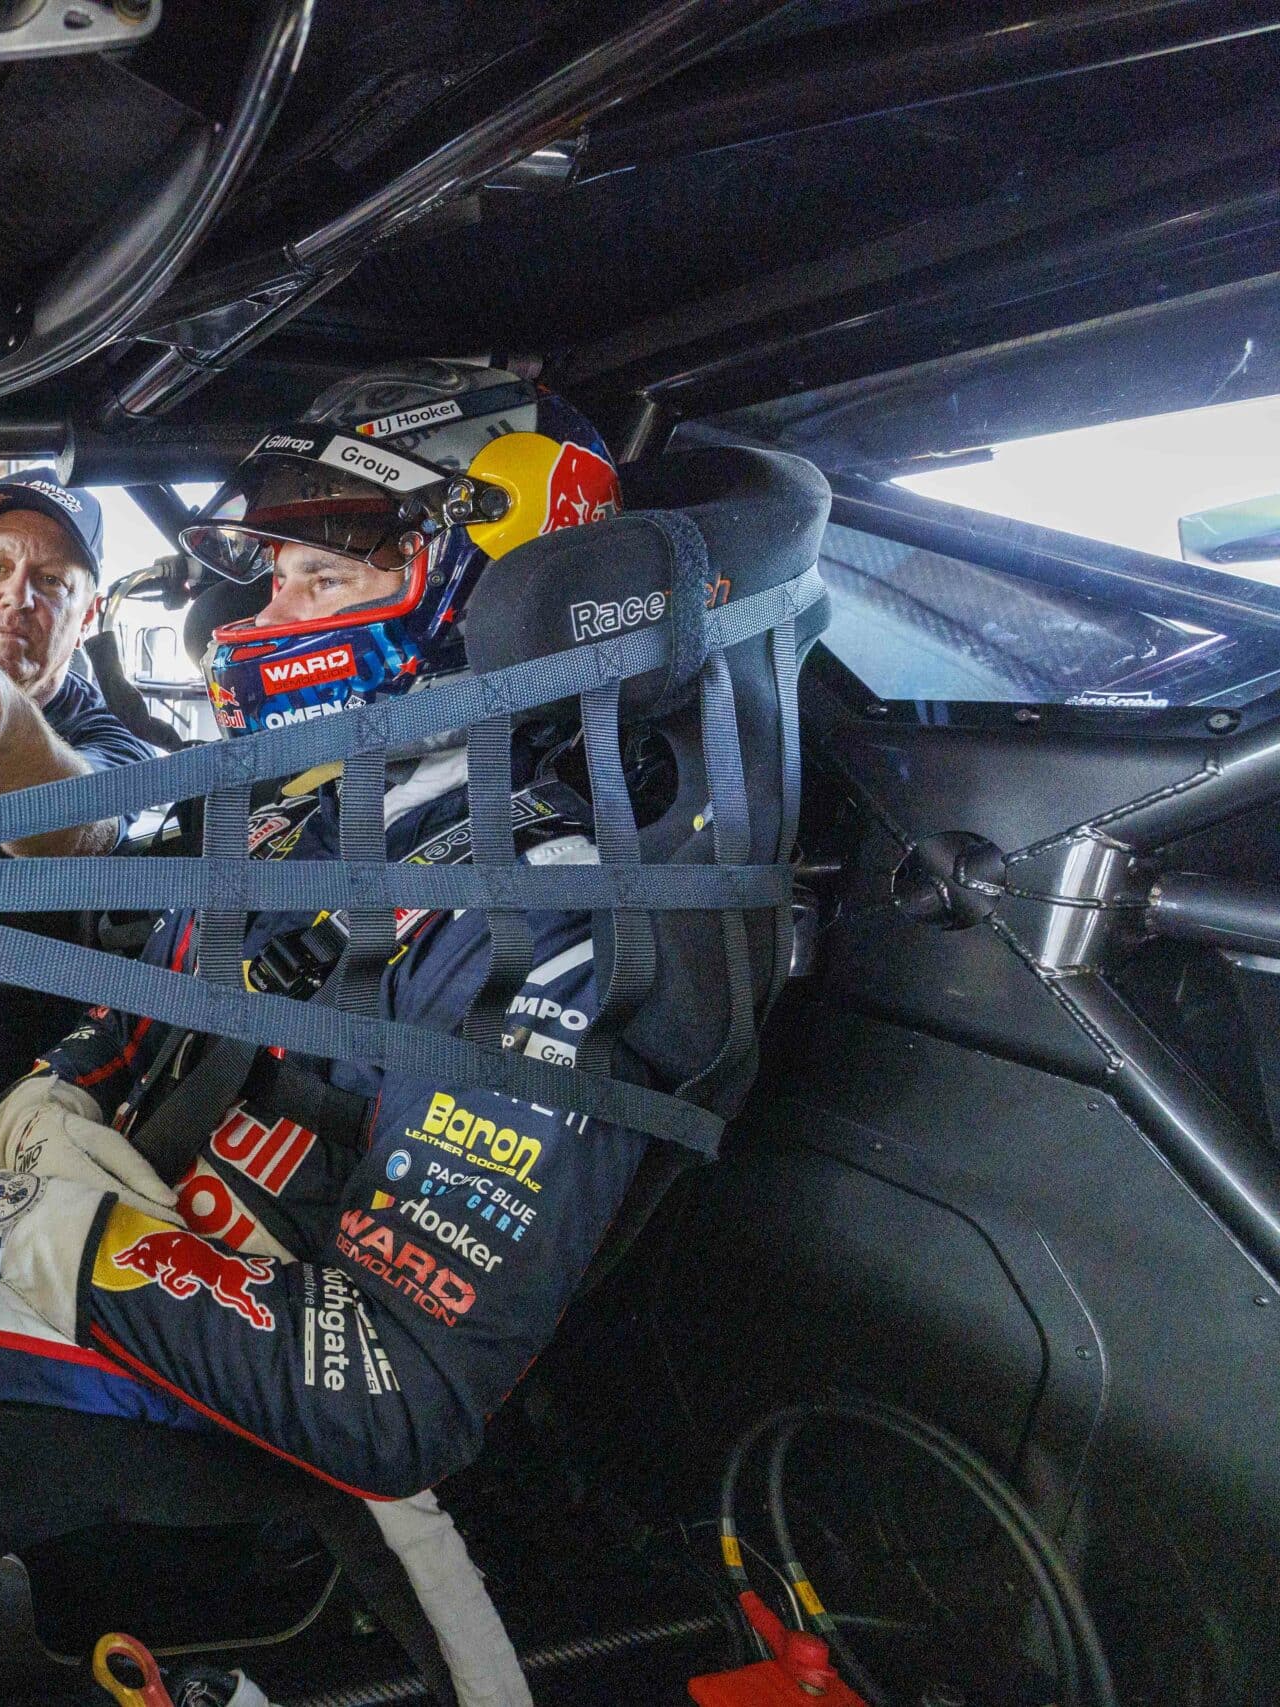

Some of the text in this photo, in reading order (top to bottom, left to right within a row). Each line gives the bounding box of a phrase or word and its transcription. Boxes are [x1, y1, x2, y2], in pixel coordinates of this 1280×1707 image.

[378, 420, 394, 434] LJ
[398, 404, 456, 428] Hooker
[267, 434, 401, 483] Giltrap Group
[31, 480, 84, 512] AMPOL
[570, 591, 666, 642] Race
[264, 650, 350, 682] WARD
[266, 700, 344, 730] OMEN
[505, 995, 594, 1031] MPO
[541, 1045, 574, 1067] Gro
[210, 1110, 317, 1197] ull
[405, 1128, 543, 1194] LEATHER GOODS NZ
[422, 1092, 542, 1184] Baron
[466, 1194, 527, 1243] CARE
[490, 1187, 538, 1226] BLUE
[399, 1197, 503, 1273] Hooker
[335, 1233, 458, 1328] DEMOLITION
[340, 1208, 477, 1315] WARD
